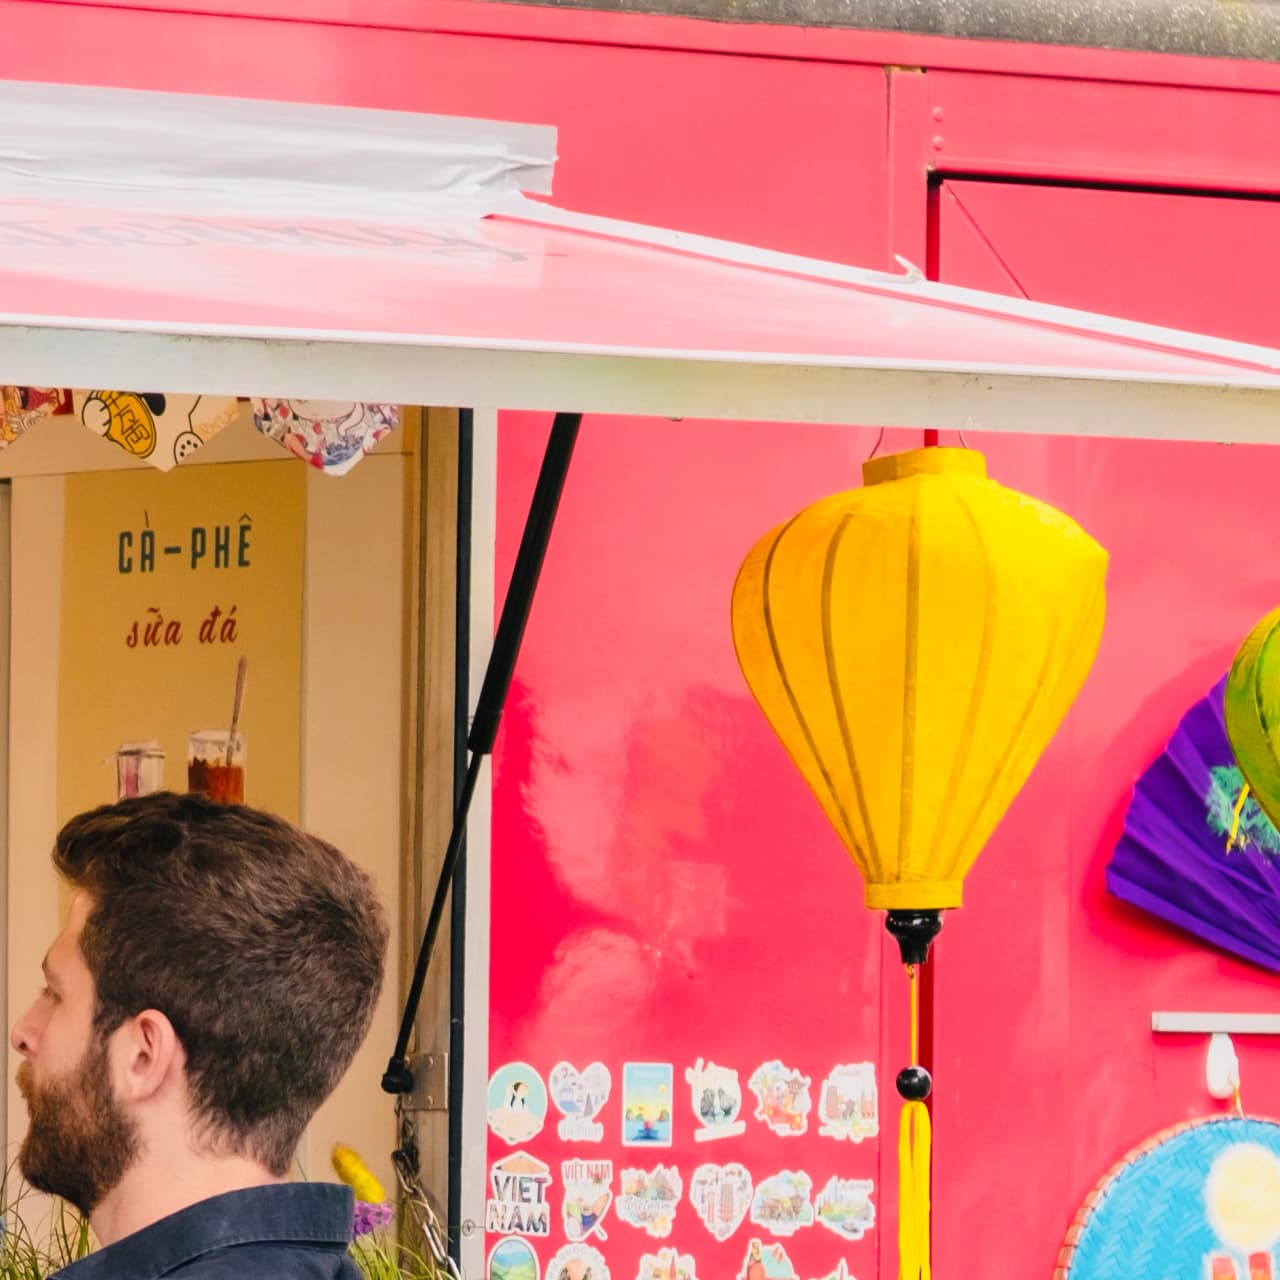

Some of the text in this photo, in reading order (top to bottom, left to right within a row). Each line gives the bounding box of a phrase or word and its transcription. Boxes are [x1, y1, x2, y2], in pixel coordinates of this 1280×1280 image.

[118, 509, 253, 574] CÀ-PHÊ
[126, 605, 238, 648] sữa đá
[494, 1175, 548, 1203] VIET
[490, 1203, 547, 1233] NAM
